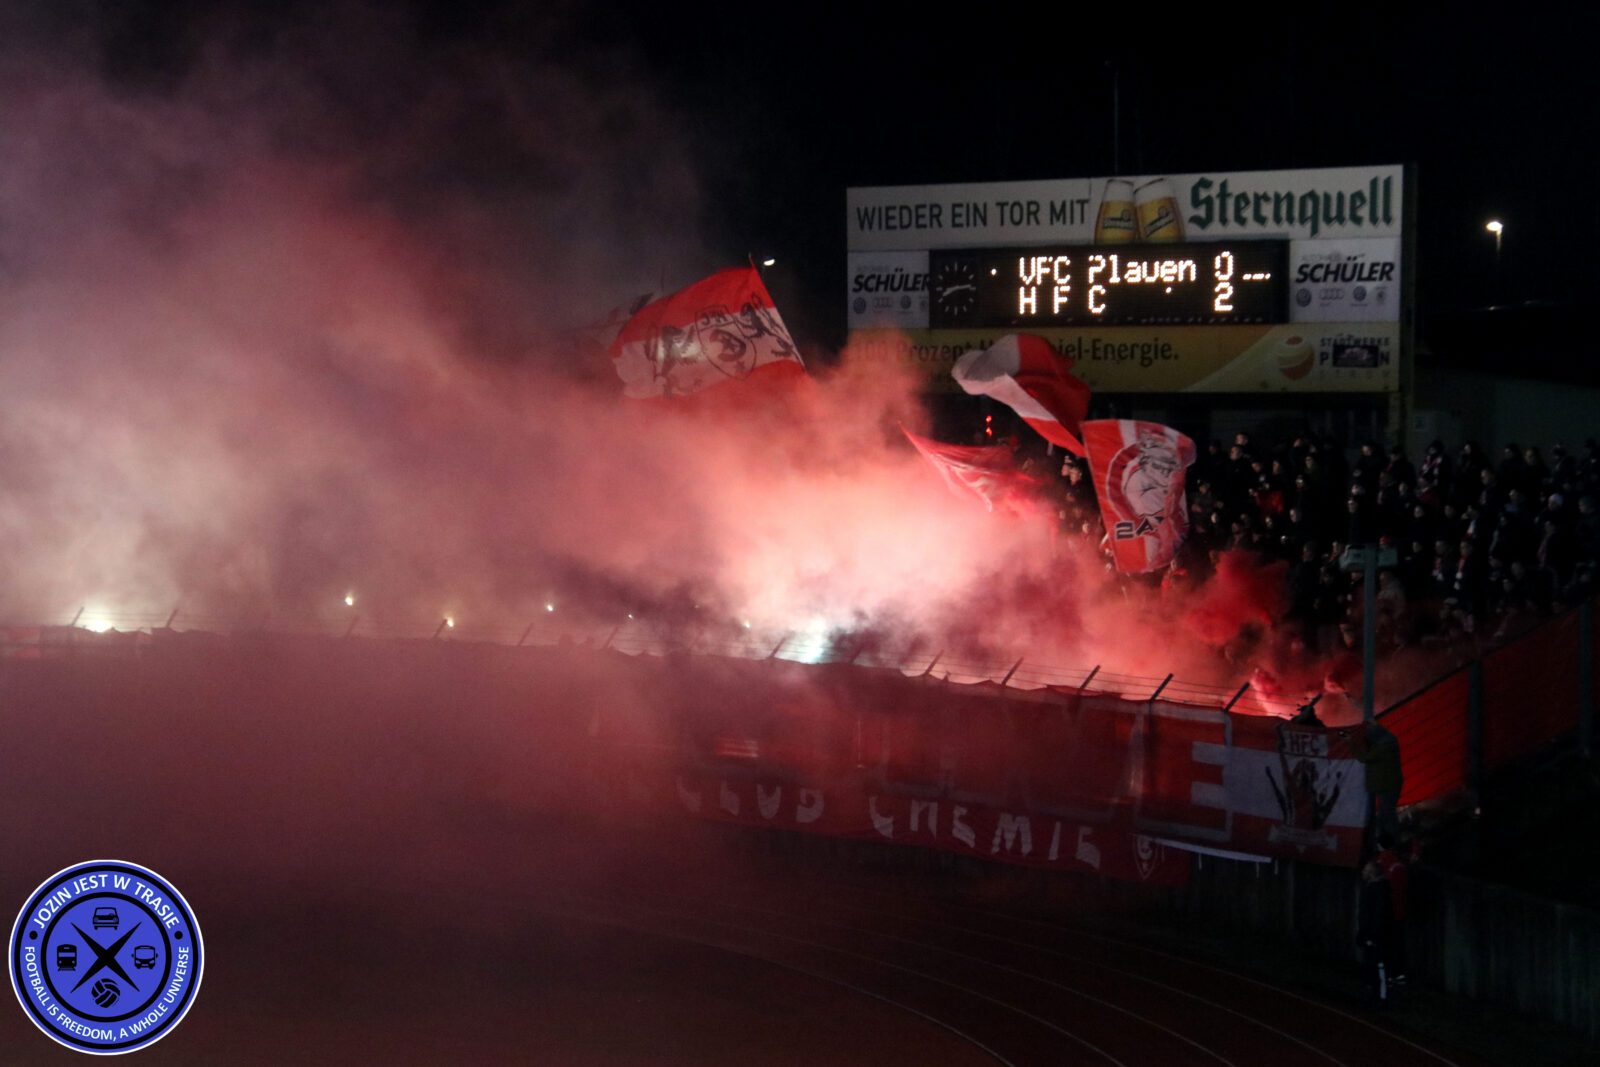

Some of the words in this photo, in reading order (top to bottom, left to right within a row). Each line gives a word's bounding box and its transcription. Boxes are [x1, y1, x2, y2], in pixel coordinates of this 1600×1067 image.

[857, 204, 942, 231] WIEDER
[951, 202, 988, 229] EIN
[996, 200, 1041, 227] TOR
[1050, 199, 1090, 225] MIT
[1188, 175, 1393, 238] Sternquell
[1019, 255, 1072, 285] VFC
[1088, 253, 1197, 284] Plauen
[1214, 250, 1234, 281] 0
[1295, 255, 1394, 283] SCHÜLER
[1019, 285, 1037, 315] H
[1053, 285, 1072, 315] F
[1088, 284, 1107, 314] C
[1214, 281, 1234, 312] 2
